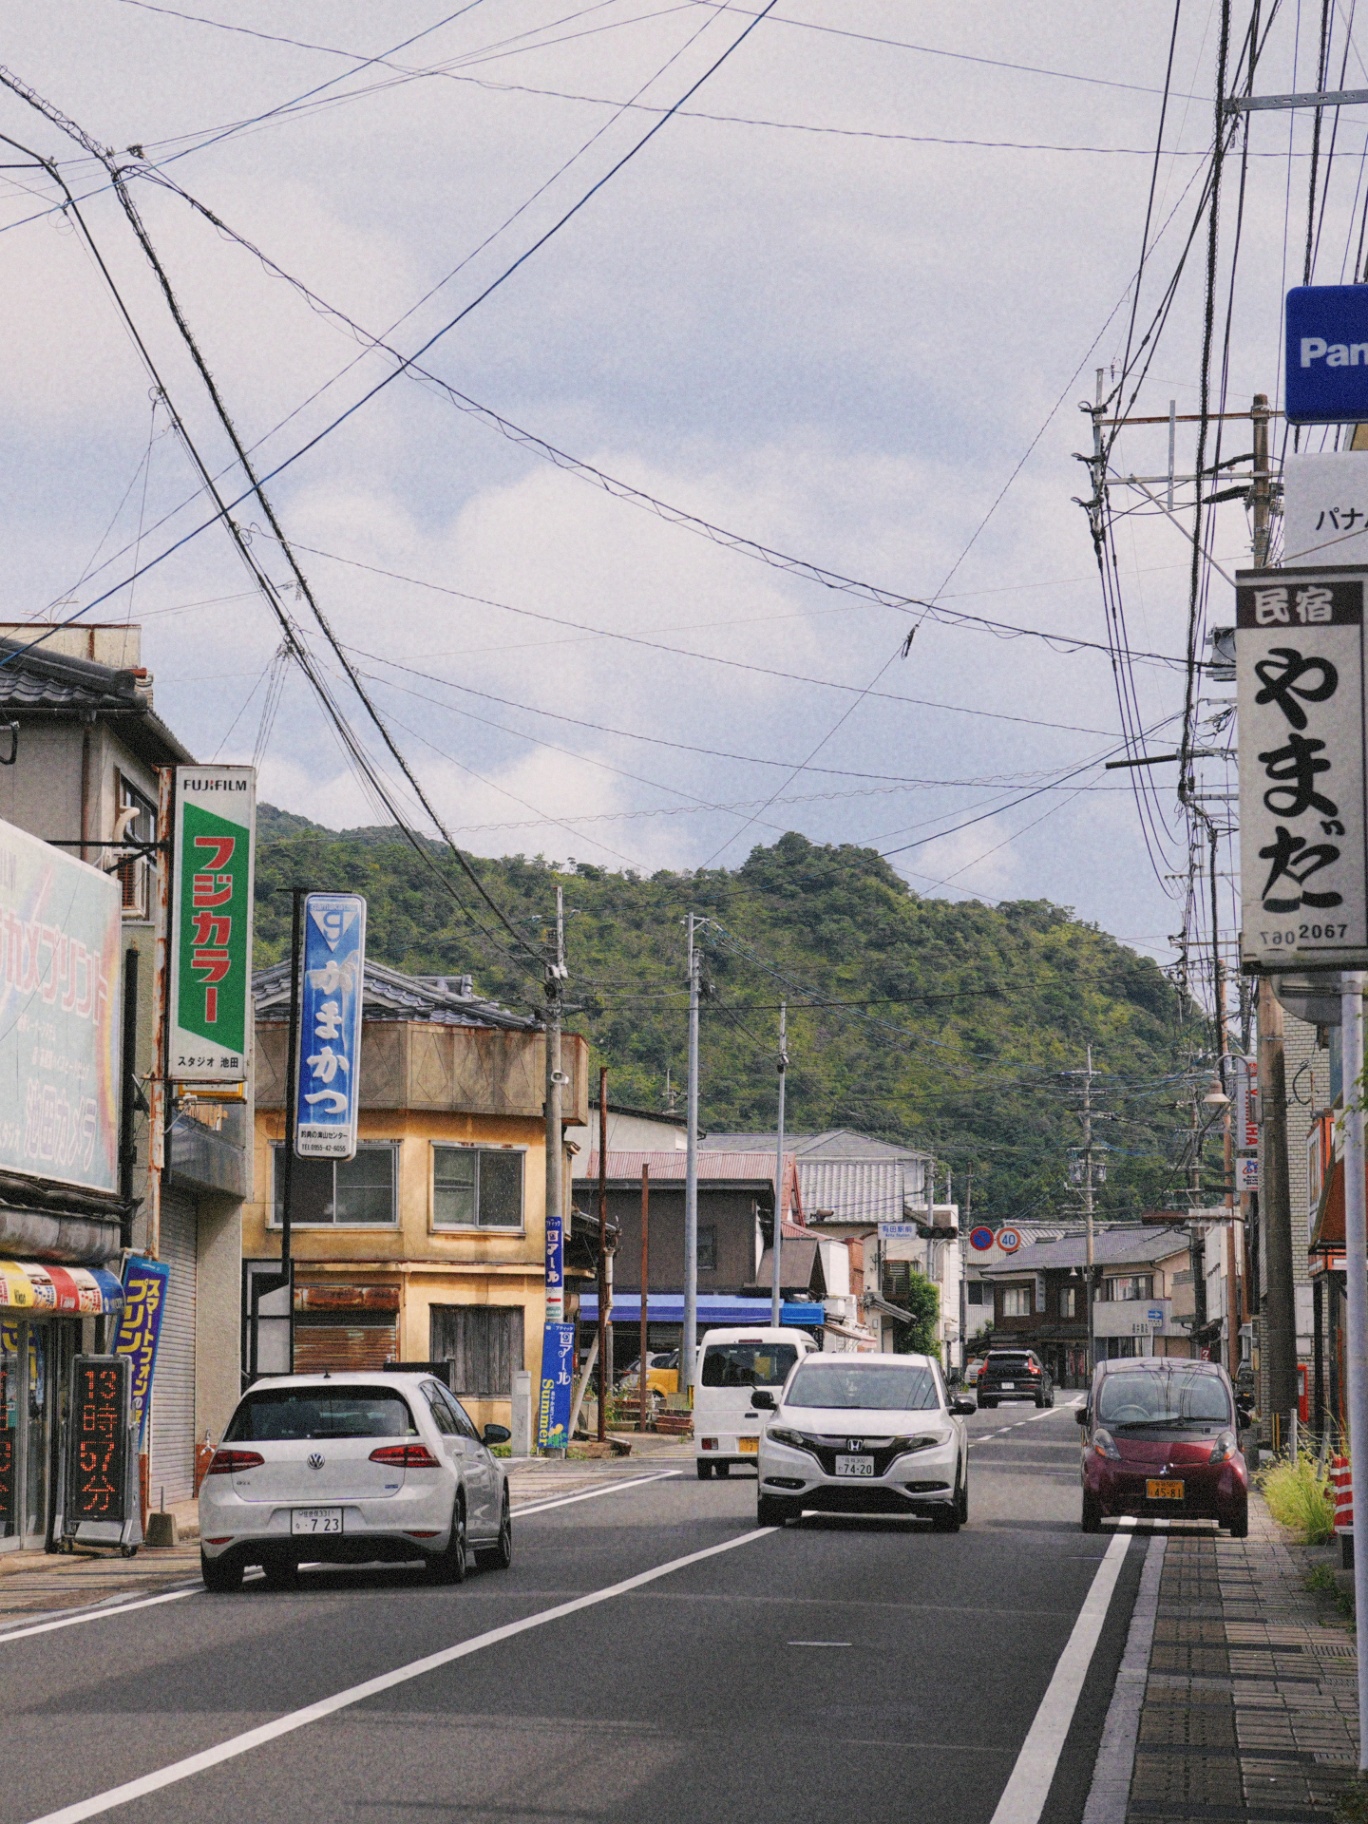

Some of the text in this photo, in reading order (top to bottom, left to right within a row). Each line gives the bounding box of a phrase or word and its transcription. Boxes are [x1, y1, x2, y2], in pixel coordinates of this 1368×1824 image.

[1316, 507, 1368, 531] パナ
[1254, 585, 1333, 625] 民宿
[183, 779, 247, 791] FUJIFILM
[1254, 647, 1344, 914] やまだ
[190, 836, 236, 1023] フジカラー
[1299, 924, 1348, 939] 2067
[304, 954, 359, 1114] がまかつ
[177, 1056, 239, 1068] スタジオ 池田
[1002, 1234, 1016, 1246] 40
[116, 1278, 149, 1372] プリン
[539, 1379, 555, 1447] Summer
[844, 1464, 872, 1474] 74-20
[1155, 1488, 1181, 1498] 45-81
